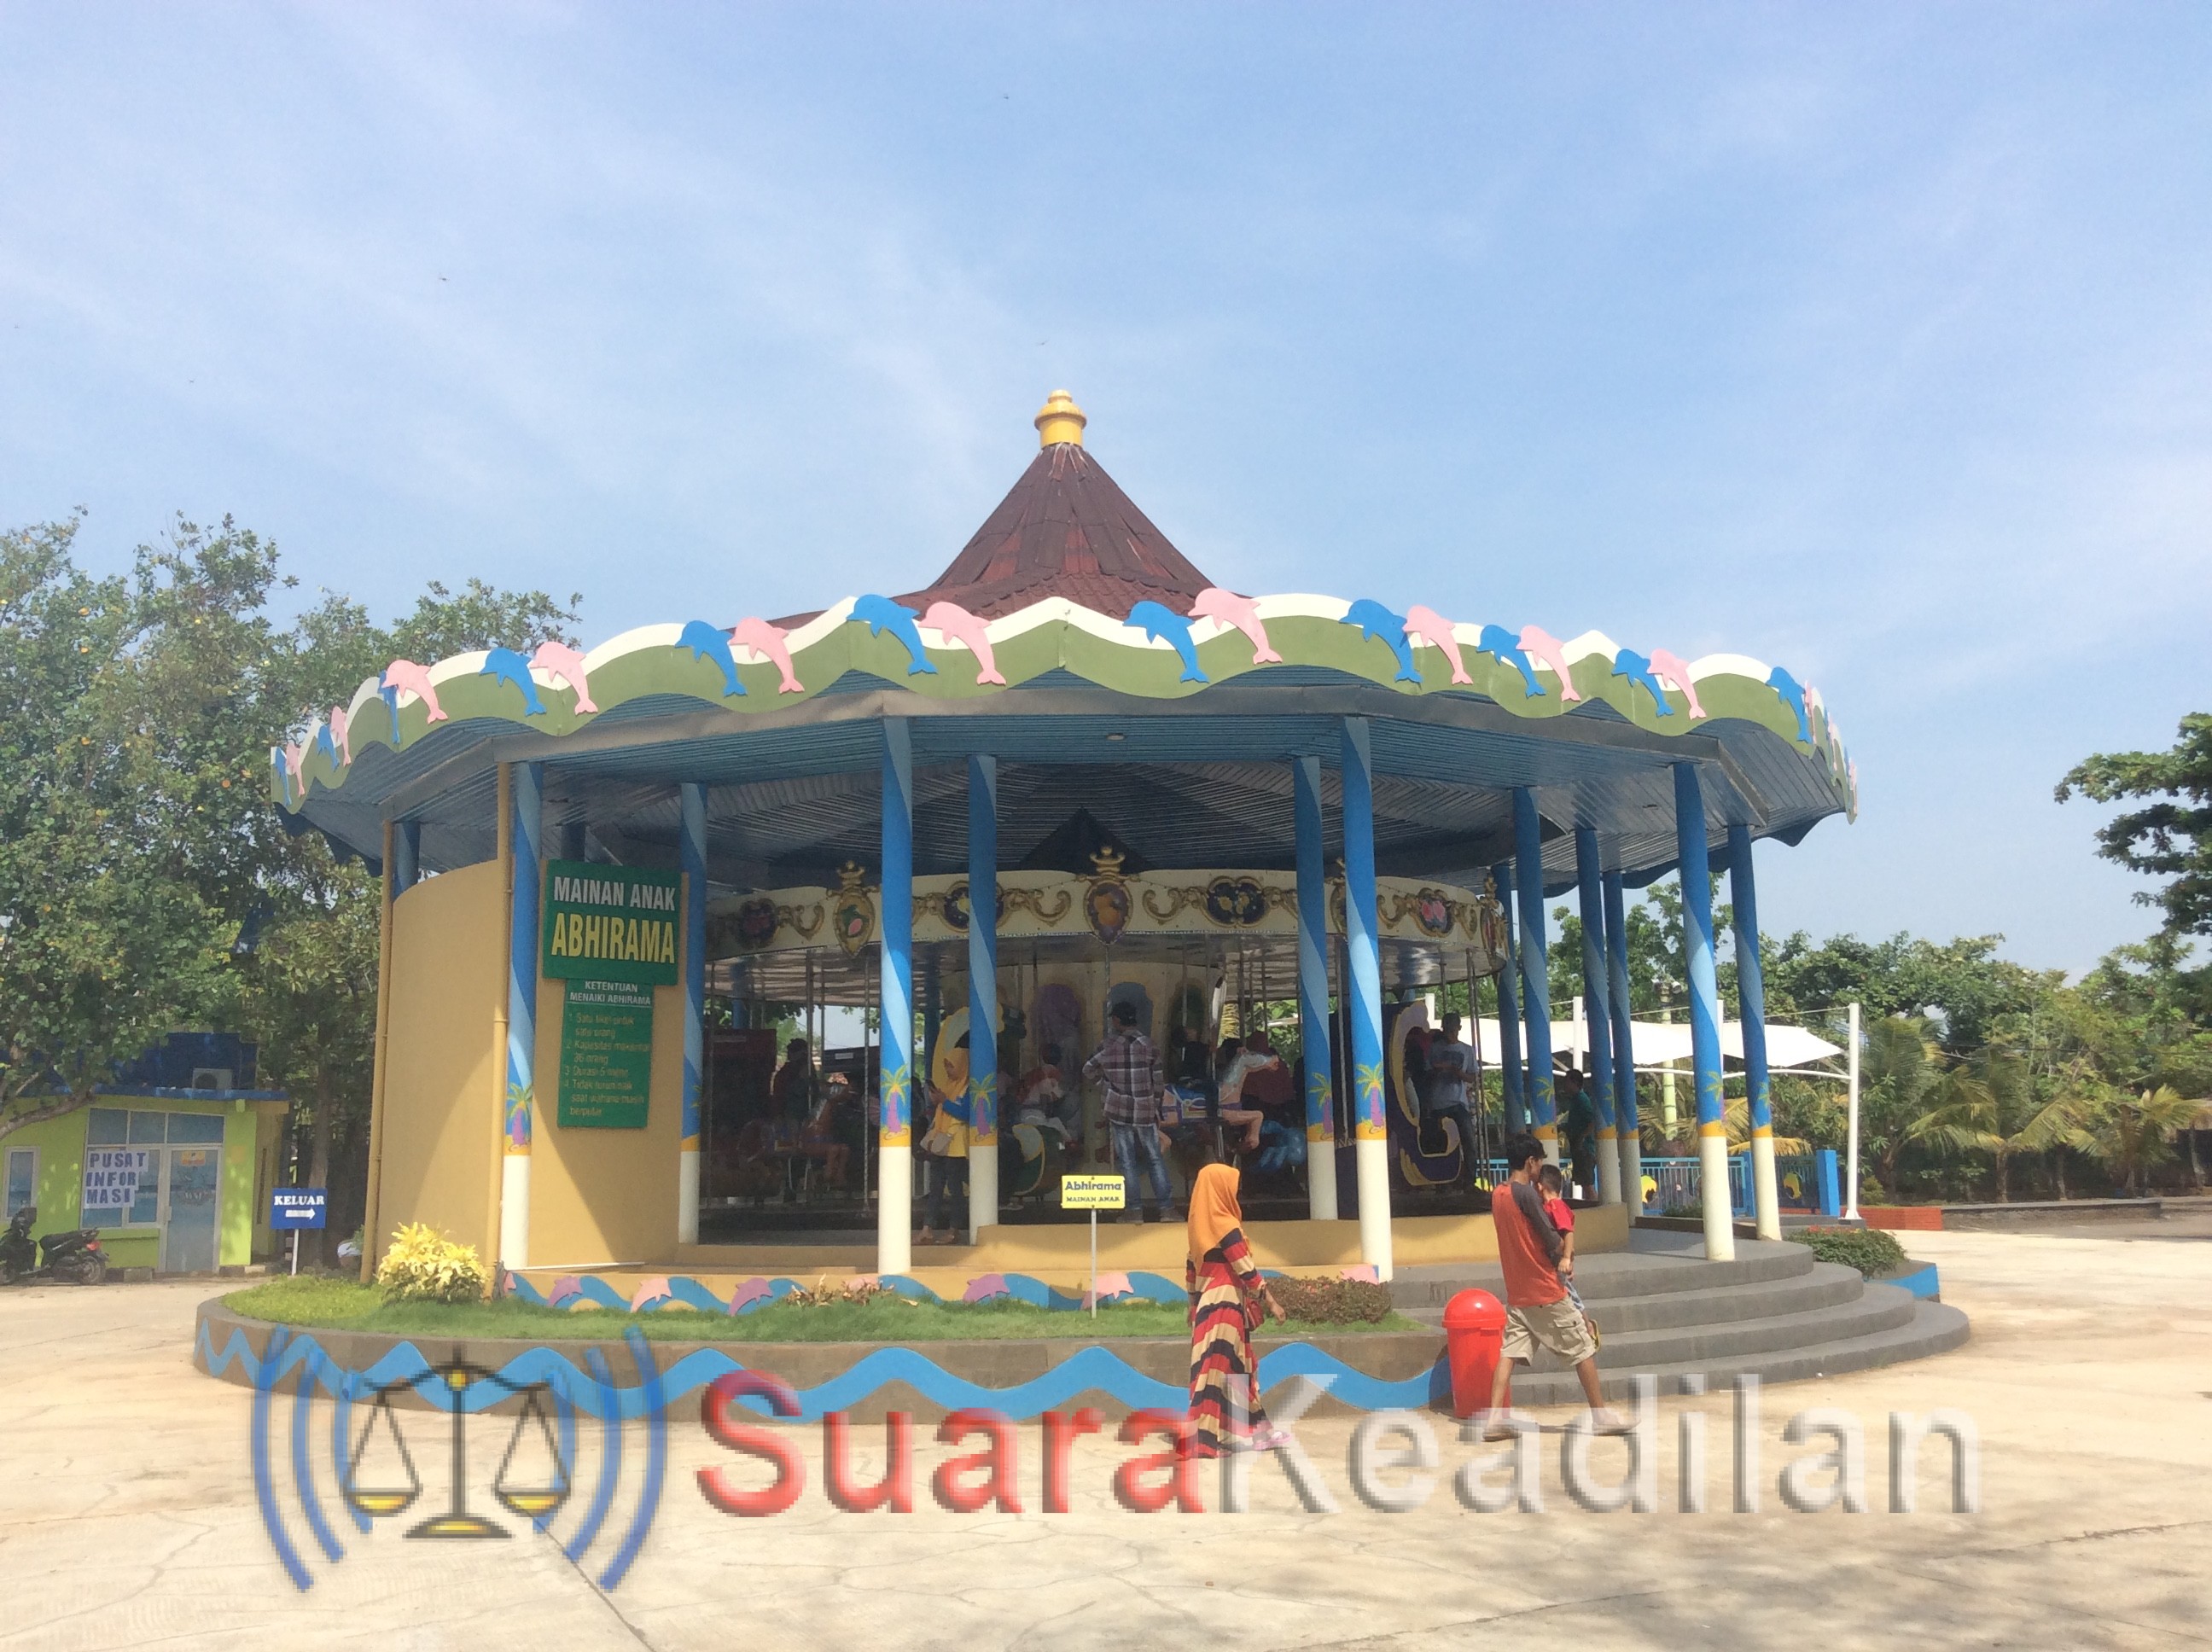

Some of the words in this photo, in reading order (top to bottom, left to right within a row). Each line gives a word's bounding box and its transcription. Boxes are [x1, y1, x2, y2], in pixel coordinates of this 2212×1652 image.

[554, 876, 625, 906] MAINAN
[630, 884, 676, 911] ANAK
[551, 912, 675, 964] ABHIRAMA
[585, 981, 638, 992] KETENTUAN
[570, 992, 605, 1003] MENAIKI
[607, 994, 651, 1005] ABHIRAMA
[90, 1152, 147, 1168] PUSAT
[86, 1171, 136, 1186] INFOR
[1065, 1181, 1122, 1190] Abhirama
[86, 1189, 131, 1204] MASI
[274, 1195, 325, 1206] KELUAR
